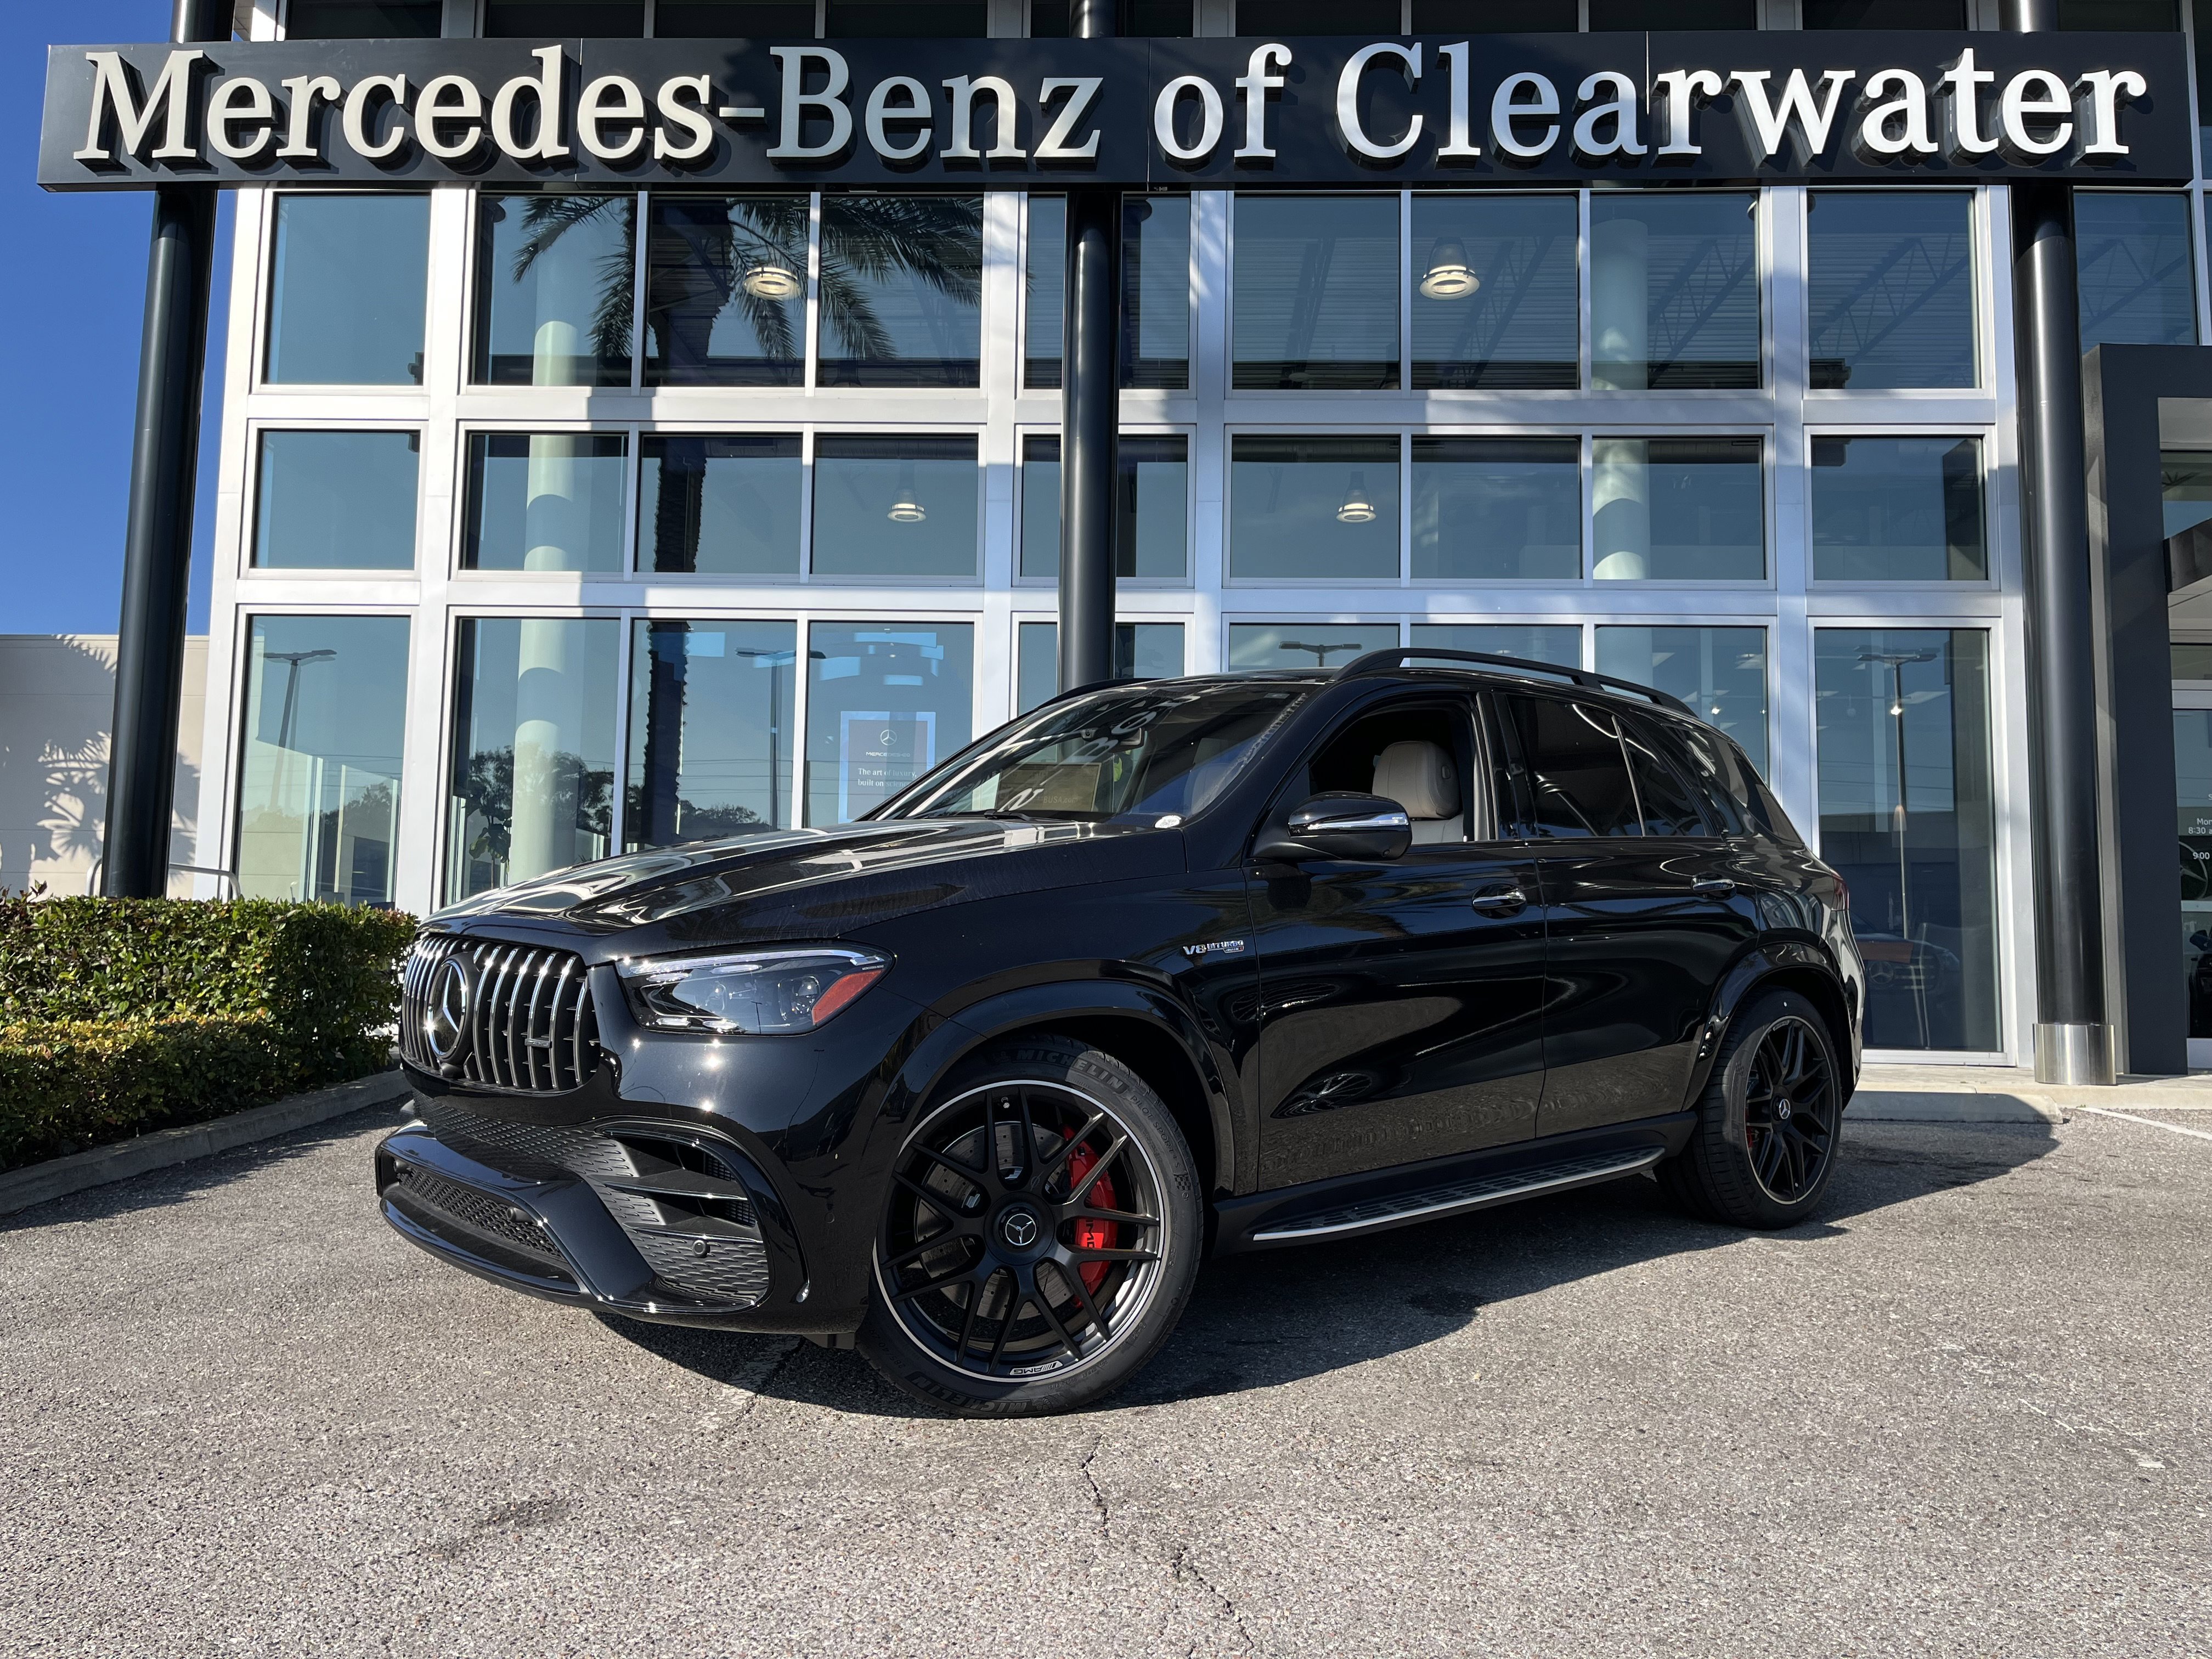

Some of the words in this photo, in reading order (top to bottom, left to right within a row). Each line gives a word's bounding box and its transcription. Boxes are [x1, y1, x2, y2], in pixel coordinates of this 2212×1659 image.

[74, 44, 1104, 160] Mercedes-Benz
[1154, 43, 1293, 159] of
[1336, 41, 2147, 158] Clearwater
[886, 780, 909, 788] scienc
[1043, 795, 1079, 804] BUSA.com
[2192, 851, 2210, 860] 9:00
[1017, 1048, 1124, 1090] MICHELIN
[1013, 1365, 1043, 1374] AMG
[912, 1375, 1028, 1413] MICHELIN
